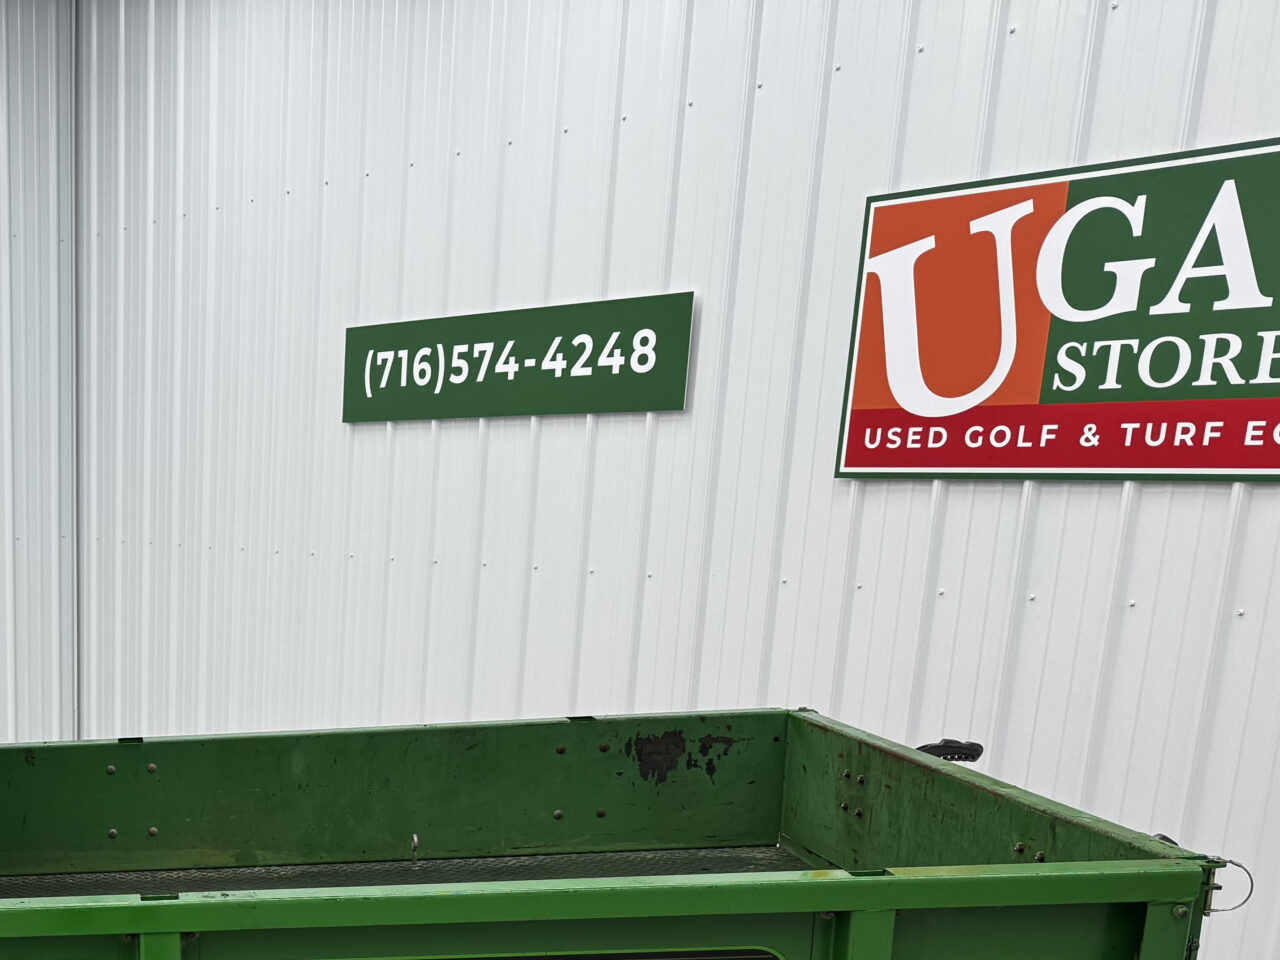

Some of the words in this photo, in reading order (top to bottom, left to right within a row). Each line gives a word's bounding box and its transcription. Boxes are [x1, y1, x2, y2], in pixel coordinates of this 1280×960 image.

[866, 178, 1274, 418] UGA
[364, 328, 658, 398] (716)574-4248
[1052, 330, 1280, 391] STORE
[864, 427, 948, 449] USED
[964, 424, 1059, 448] GOLF
[1079, 423, 1100, 447] &
[1120, 421, 1225, 447] TURF
[1243, 420, 1280, 446] E
